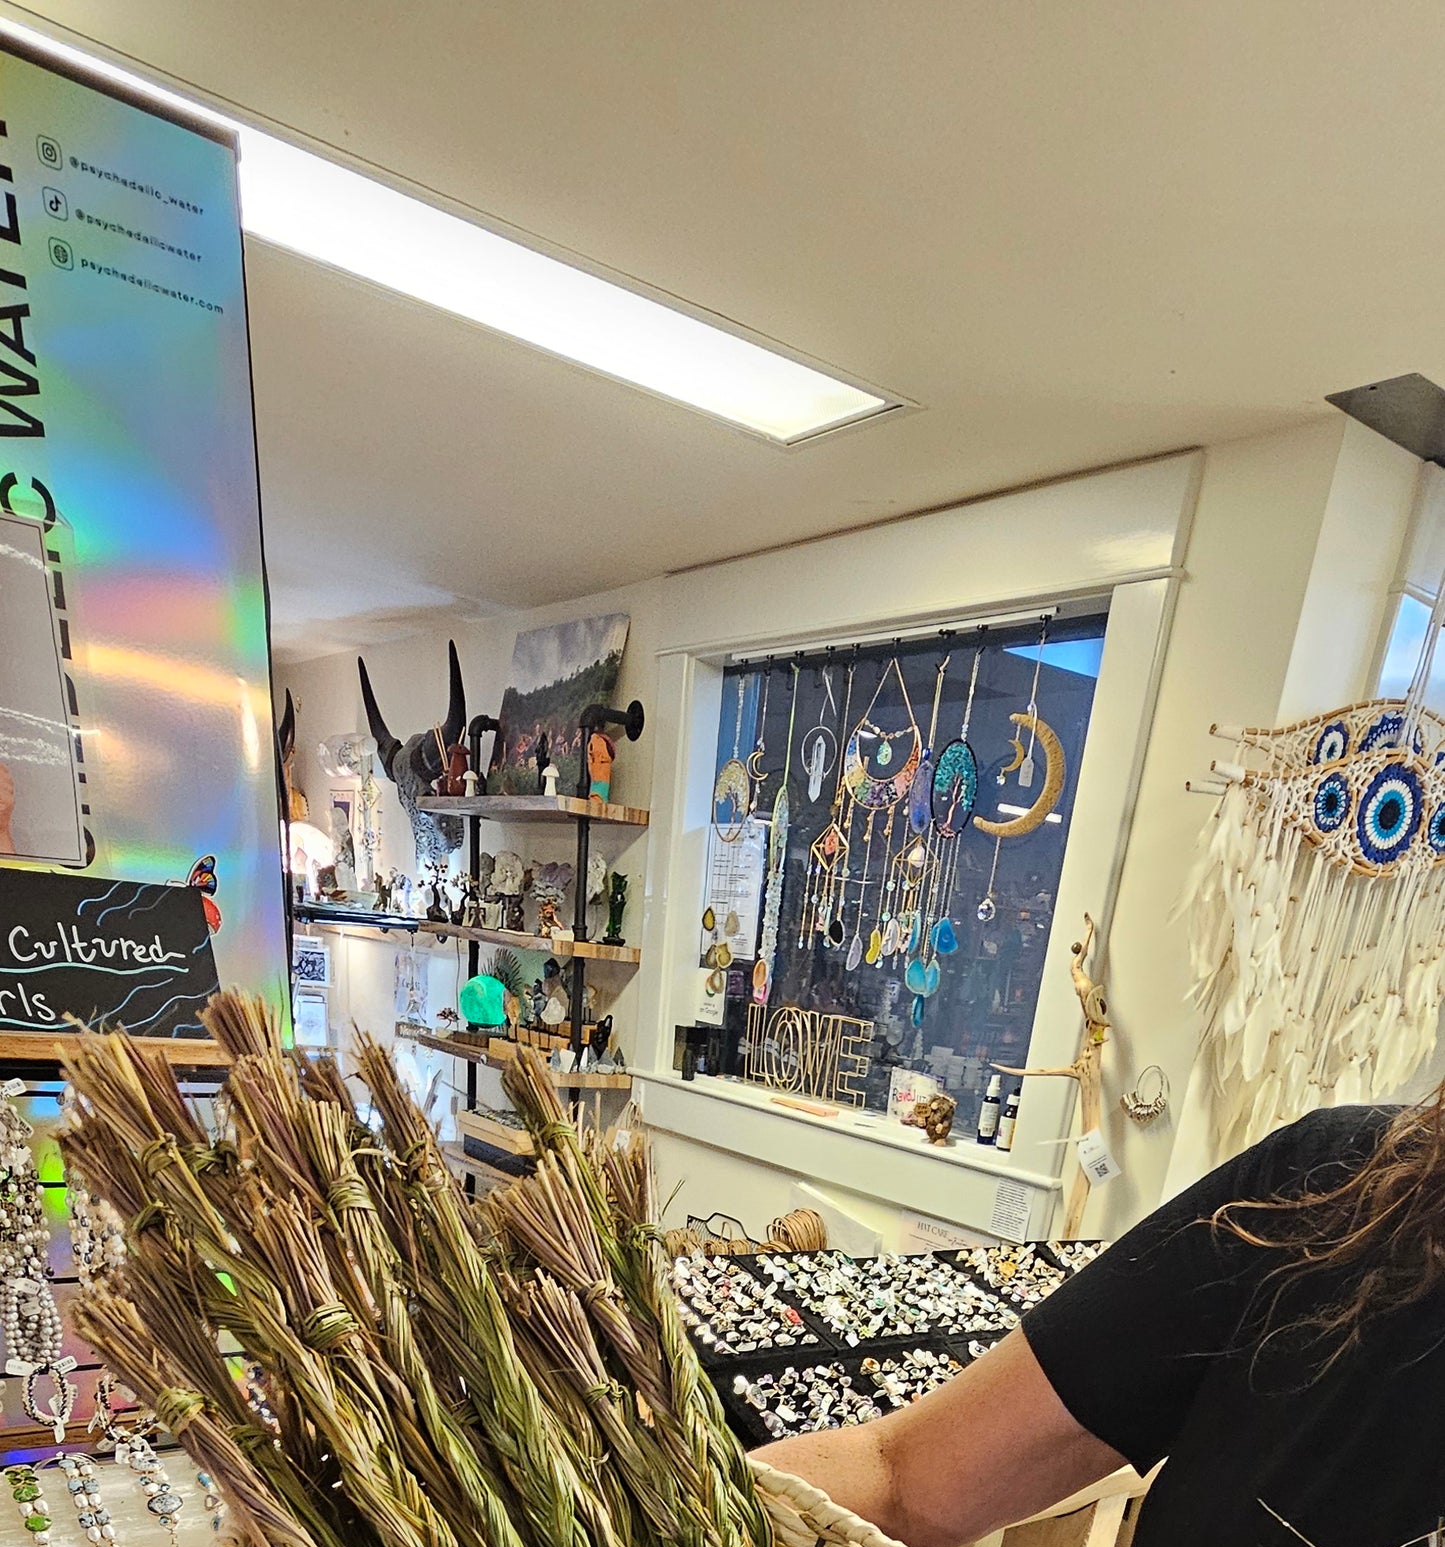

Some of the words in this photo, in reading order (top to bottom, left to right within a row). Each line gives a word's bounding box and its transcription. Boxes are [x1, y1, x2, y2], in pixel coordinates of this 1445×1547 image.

[69, 156, 204, 215] @psychedelic_water
[75, 208, 202, 262] @psychedelicwater
[81, 257, 224, 315] psychedelicwater.com
[8, 922, 186, 963] Cultured
[744, 1003, 874, 1110] LOVE
